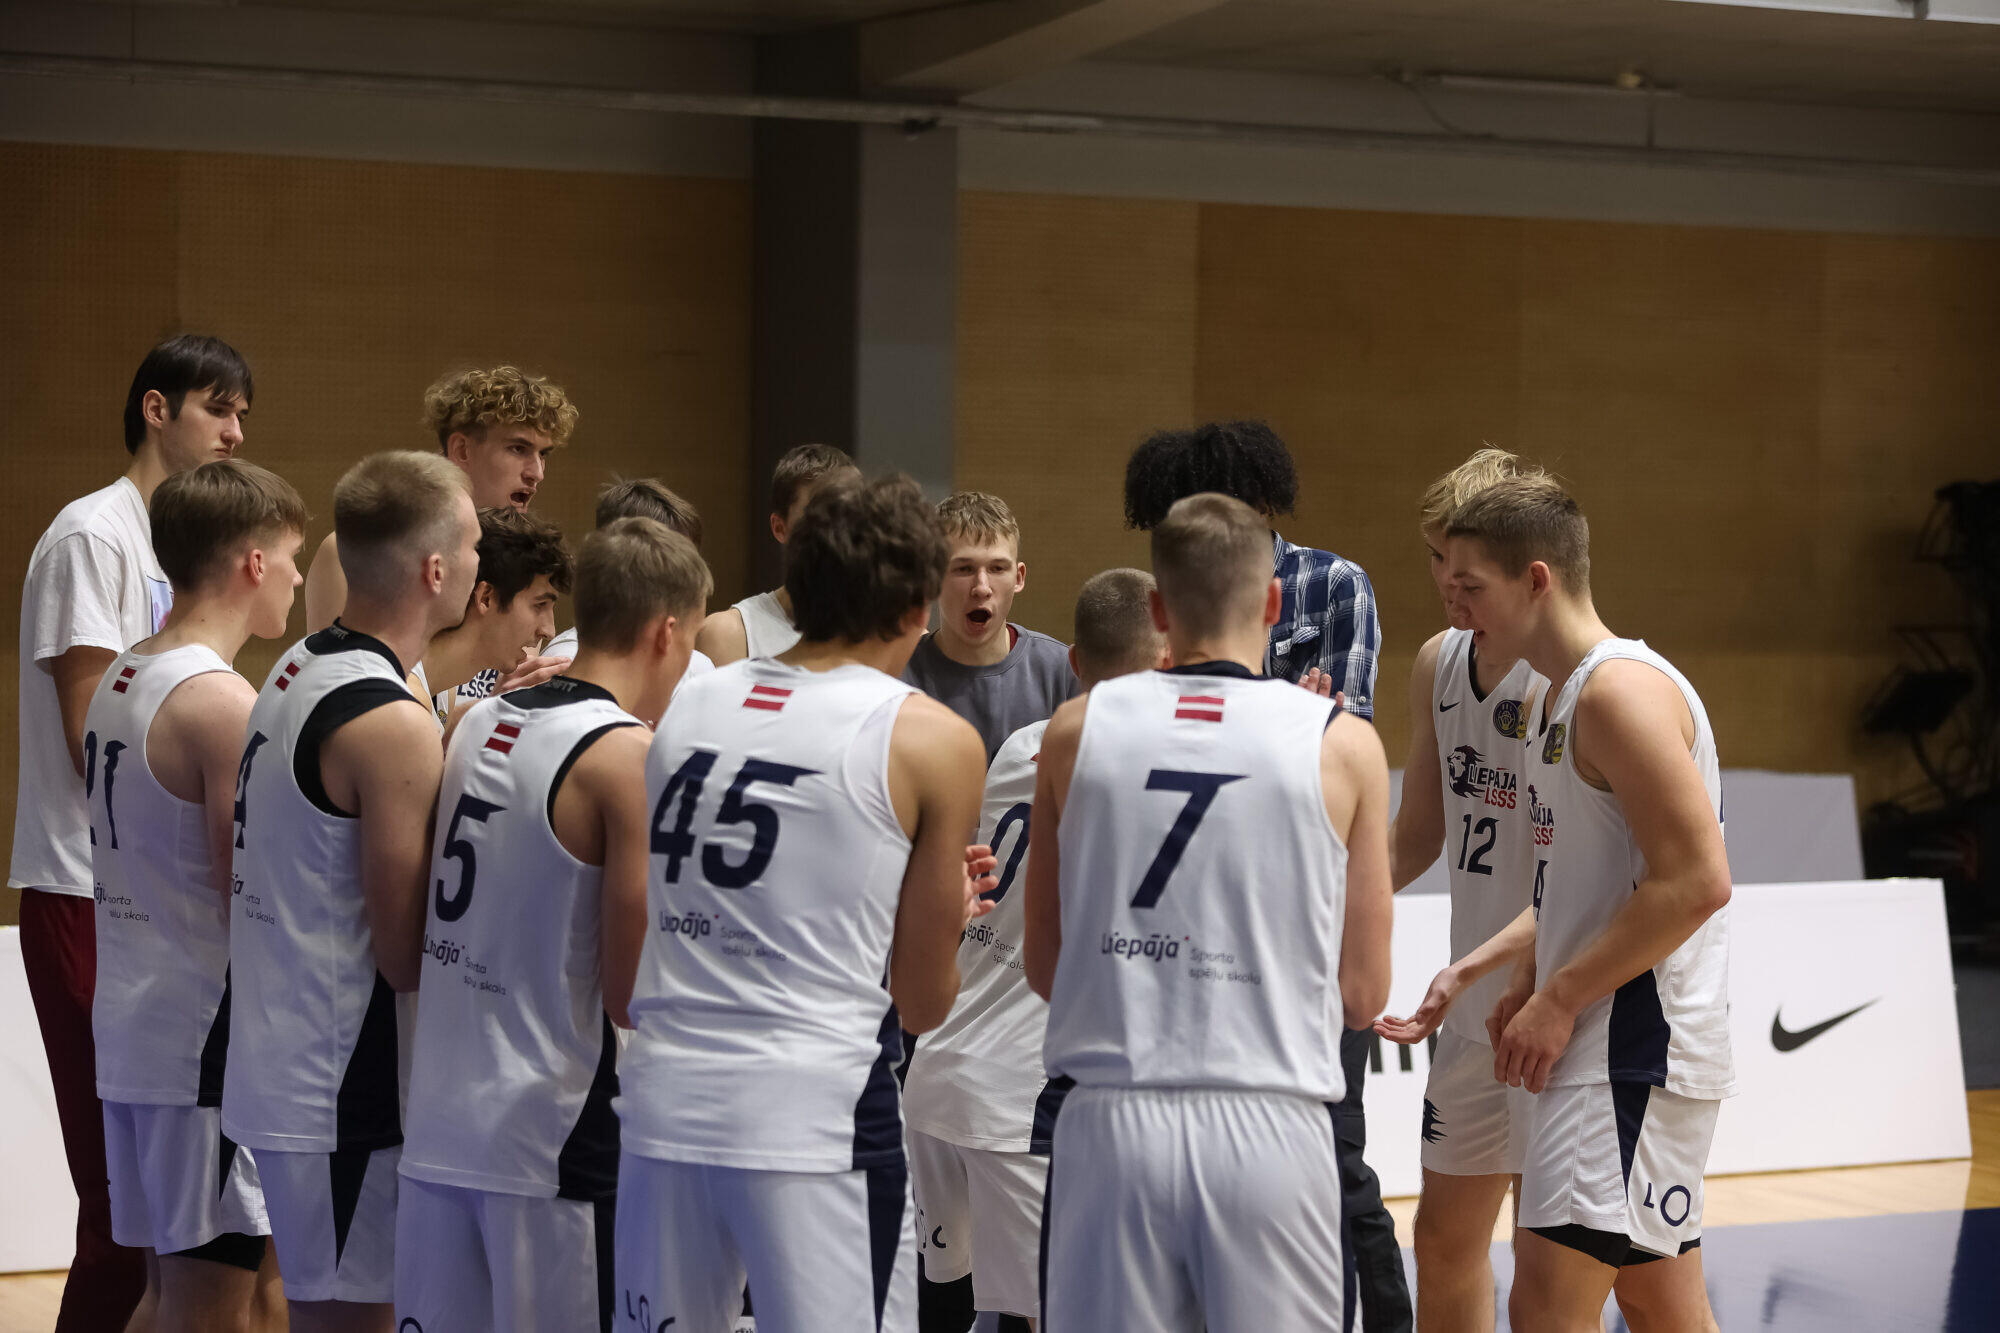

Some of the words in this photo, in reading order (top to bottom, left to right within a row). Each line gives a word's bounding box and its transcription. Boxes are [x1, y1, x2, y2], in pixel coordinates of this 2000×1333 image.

[650, 750, 826, 889] 45
[1485, 787, 1517, 810] LSSS
[435, 793, 508, 922] 5
[1130, 769, 1251, 909] 7
[1458, 814, 1500, 876] 12
[1534, 826, 1554, 846] SSS
[124, 908, 149, 922] skola
[1102, 932, 1180, 963] Liepāja
